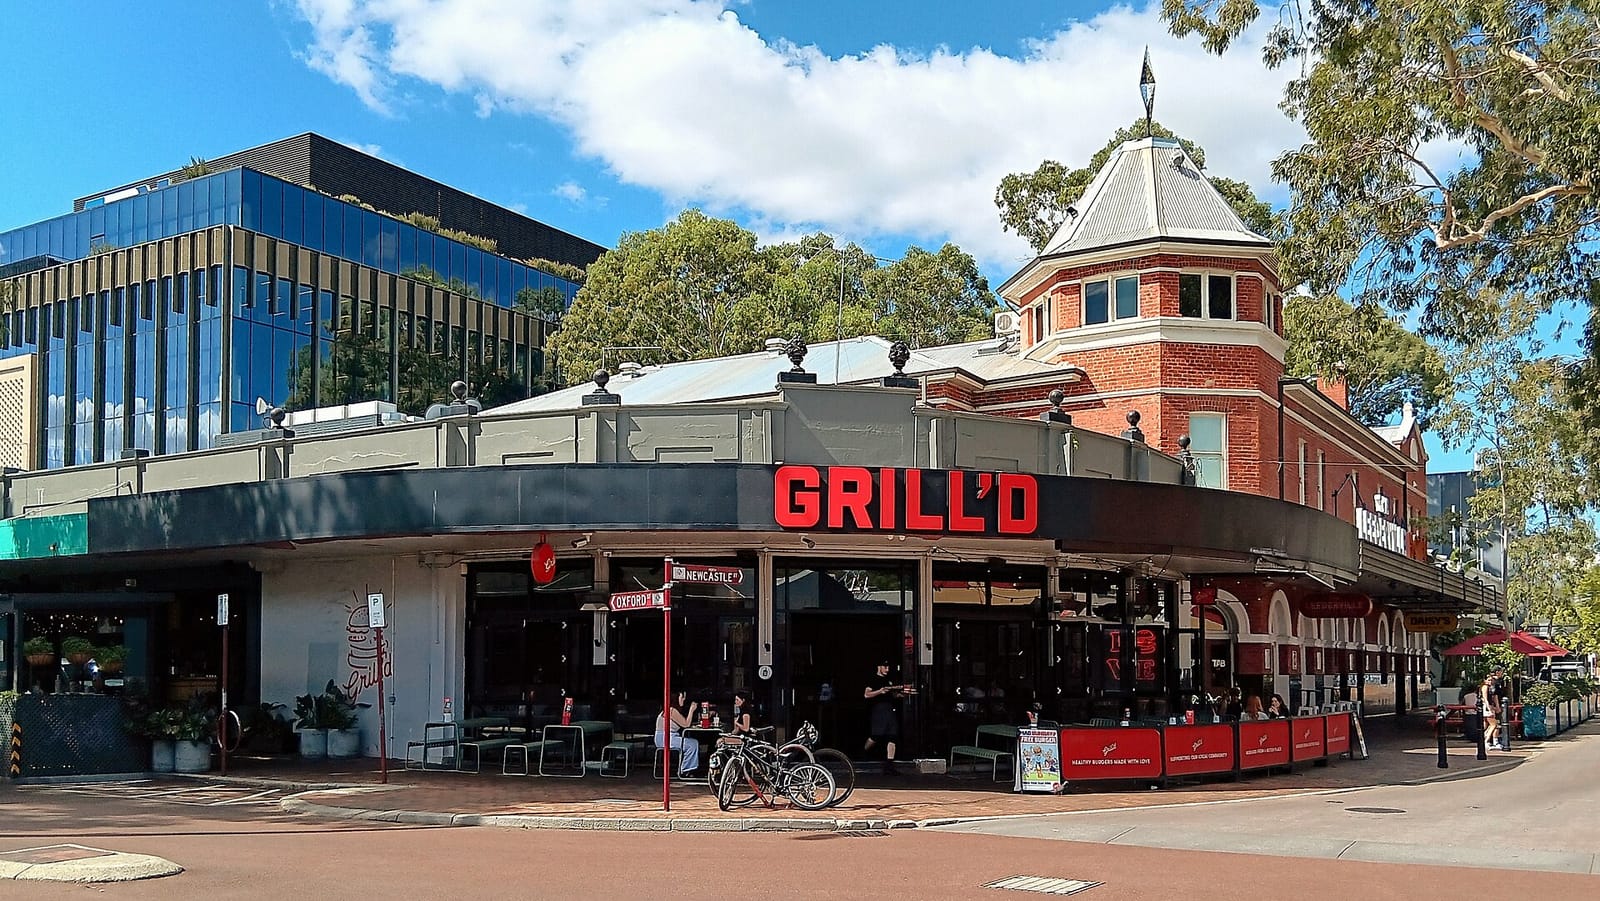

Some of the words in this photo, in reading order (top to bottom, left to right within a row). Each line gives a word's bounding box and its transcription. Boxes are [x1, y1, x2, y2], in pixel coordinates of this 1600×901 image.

[686, 570, 733, 582] NEWCASTLE
[372, 598, 379, 606] P
[616, 594, 647, 608] OXFORD
[1410, 616, 1451, 625] DAISY'S
[1211, 658, 1226, 668] TAB
